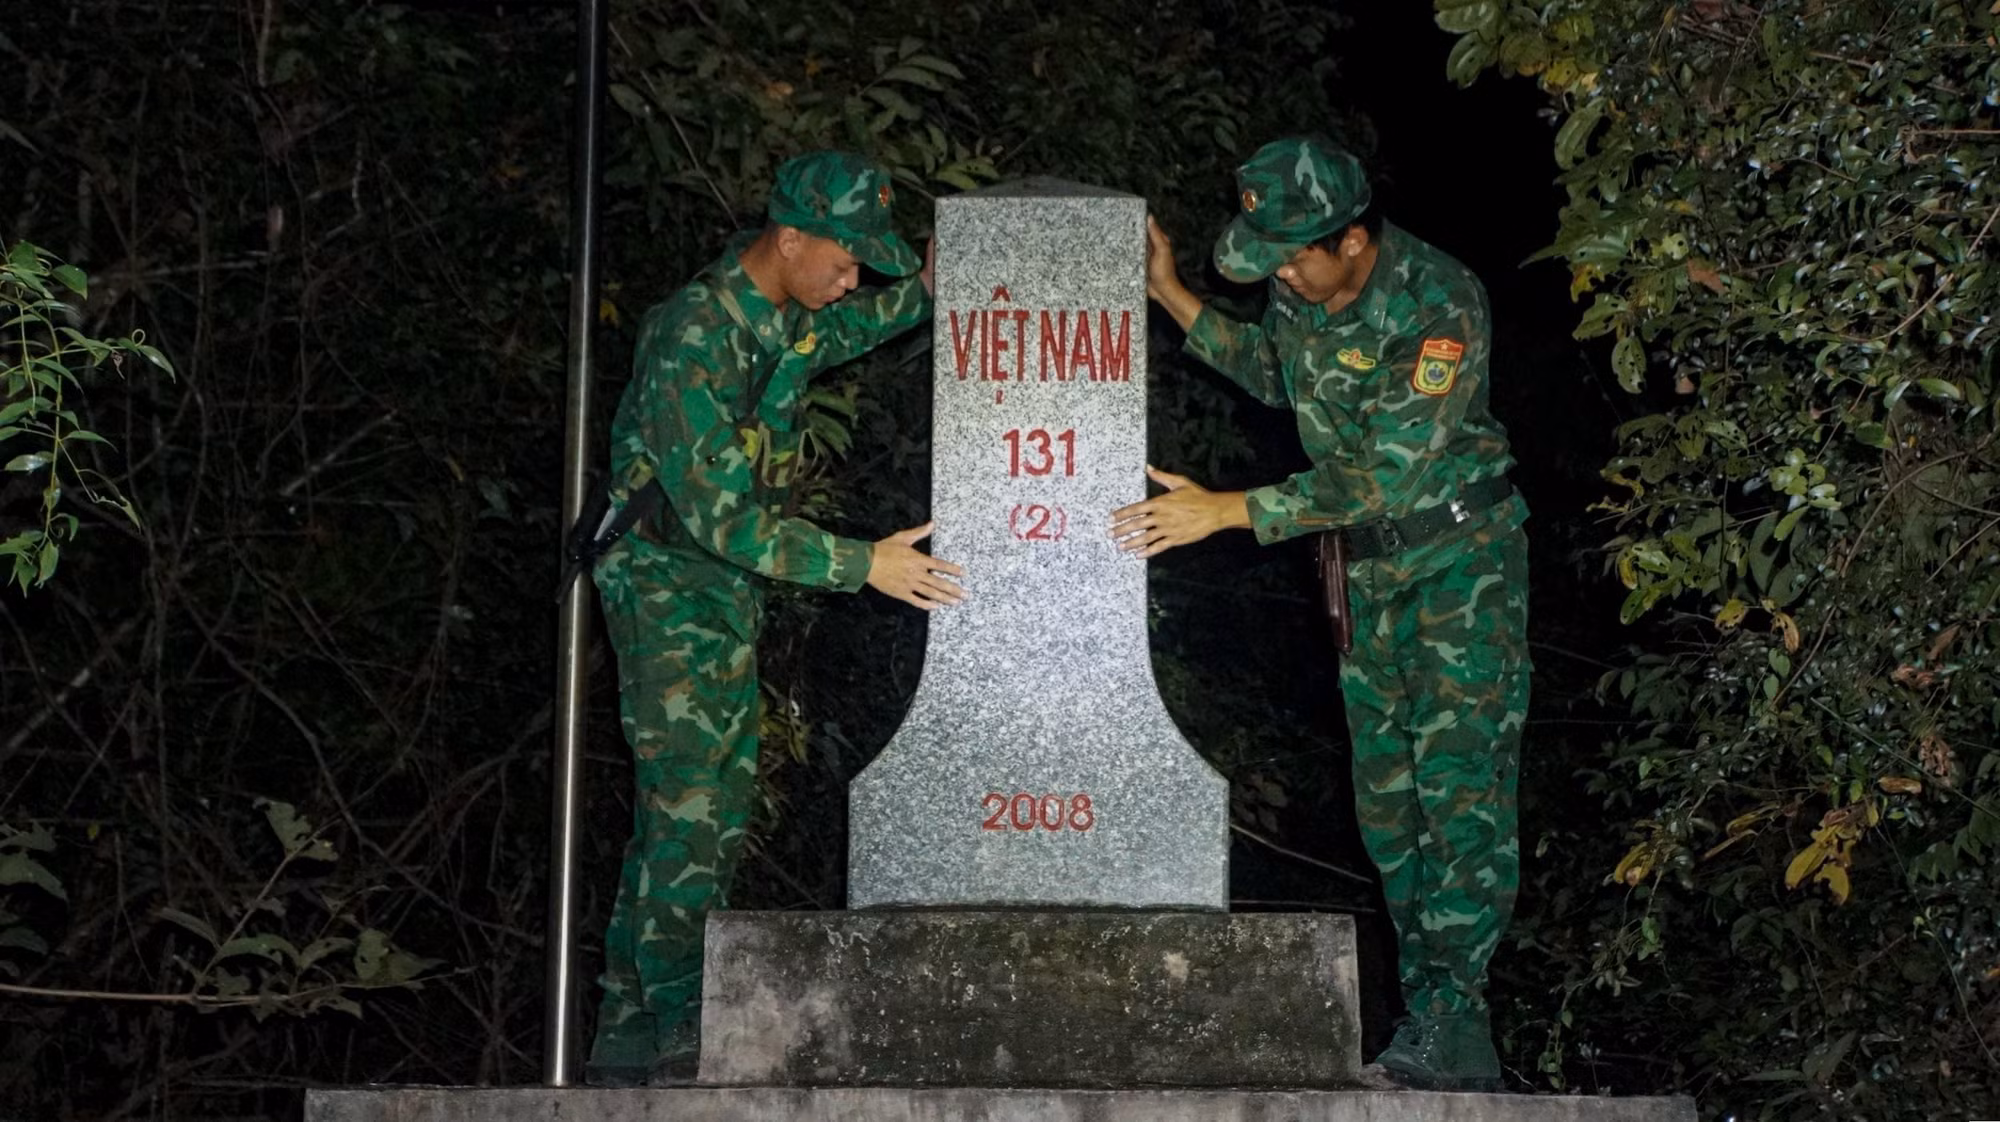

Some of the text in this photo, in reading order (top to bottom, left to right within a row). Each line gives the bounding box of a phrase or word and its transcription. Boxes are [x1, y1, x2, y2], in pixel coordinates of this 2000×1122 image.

[949, 284, 1131, 404] VIỆT NAM
[1002, 428, 1076, 478] 131
[1009, 504, 1067, 541] (2)
[982, 792, 1094, 832] 2008
